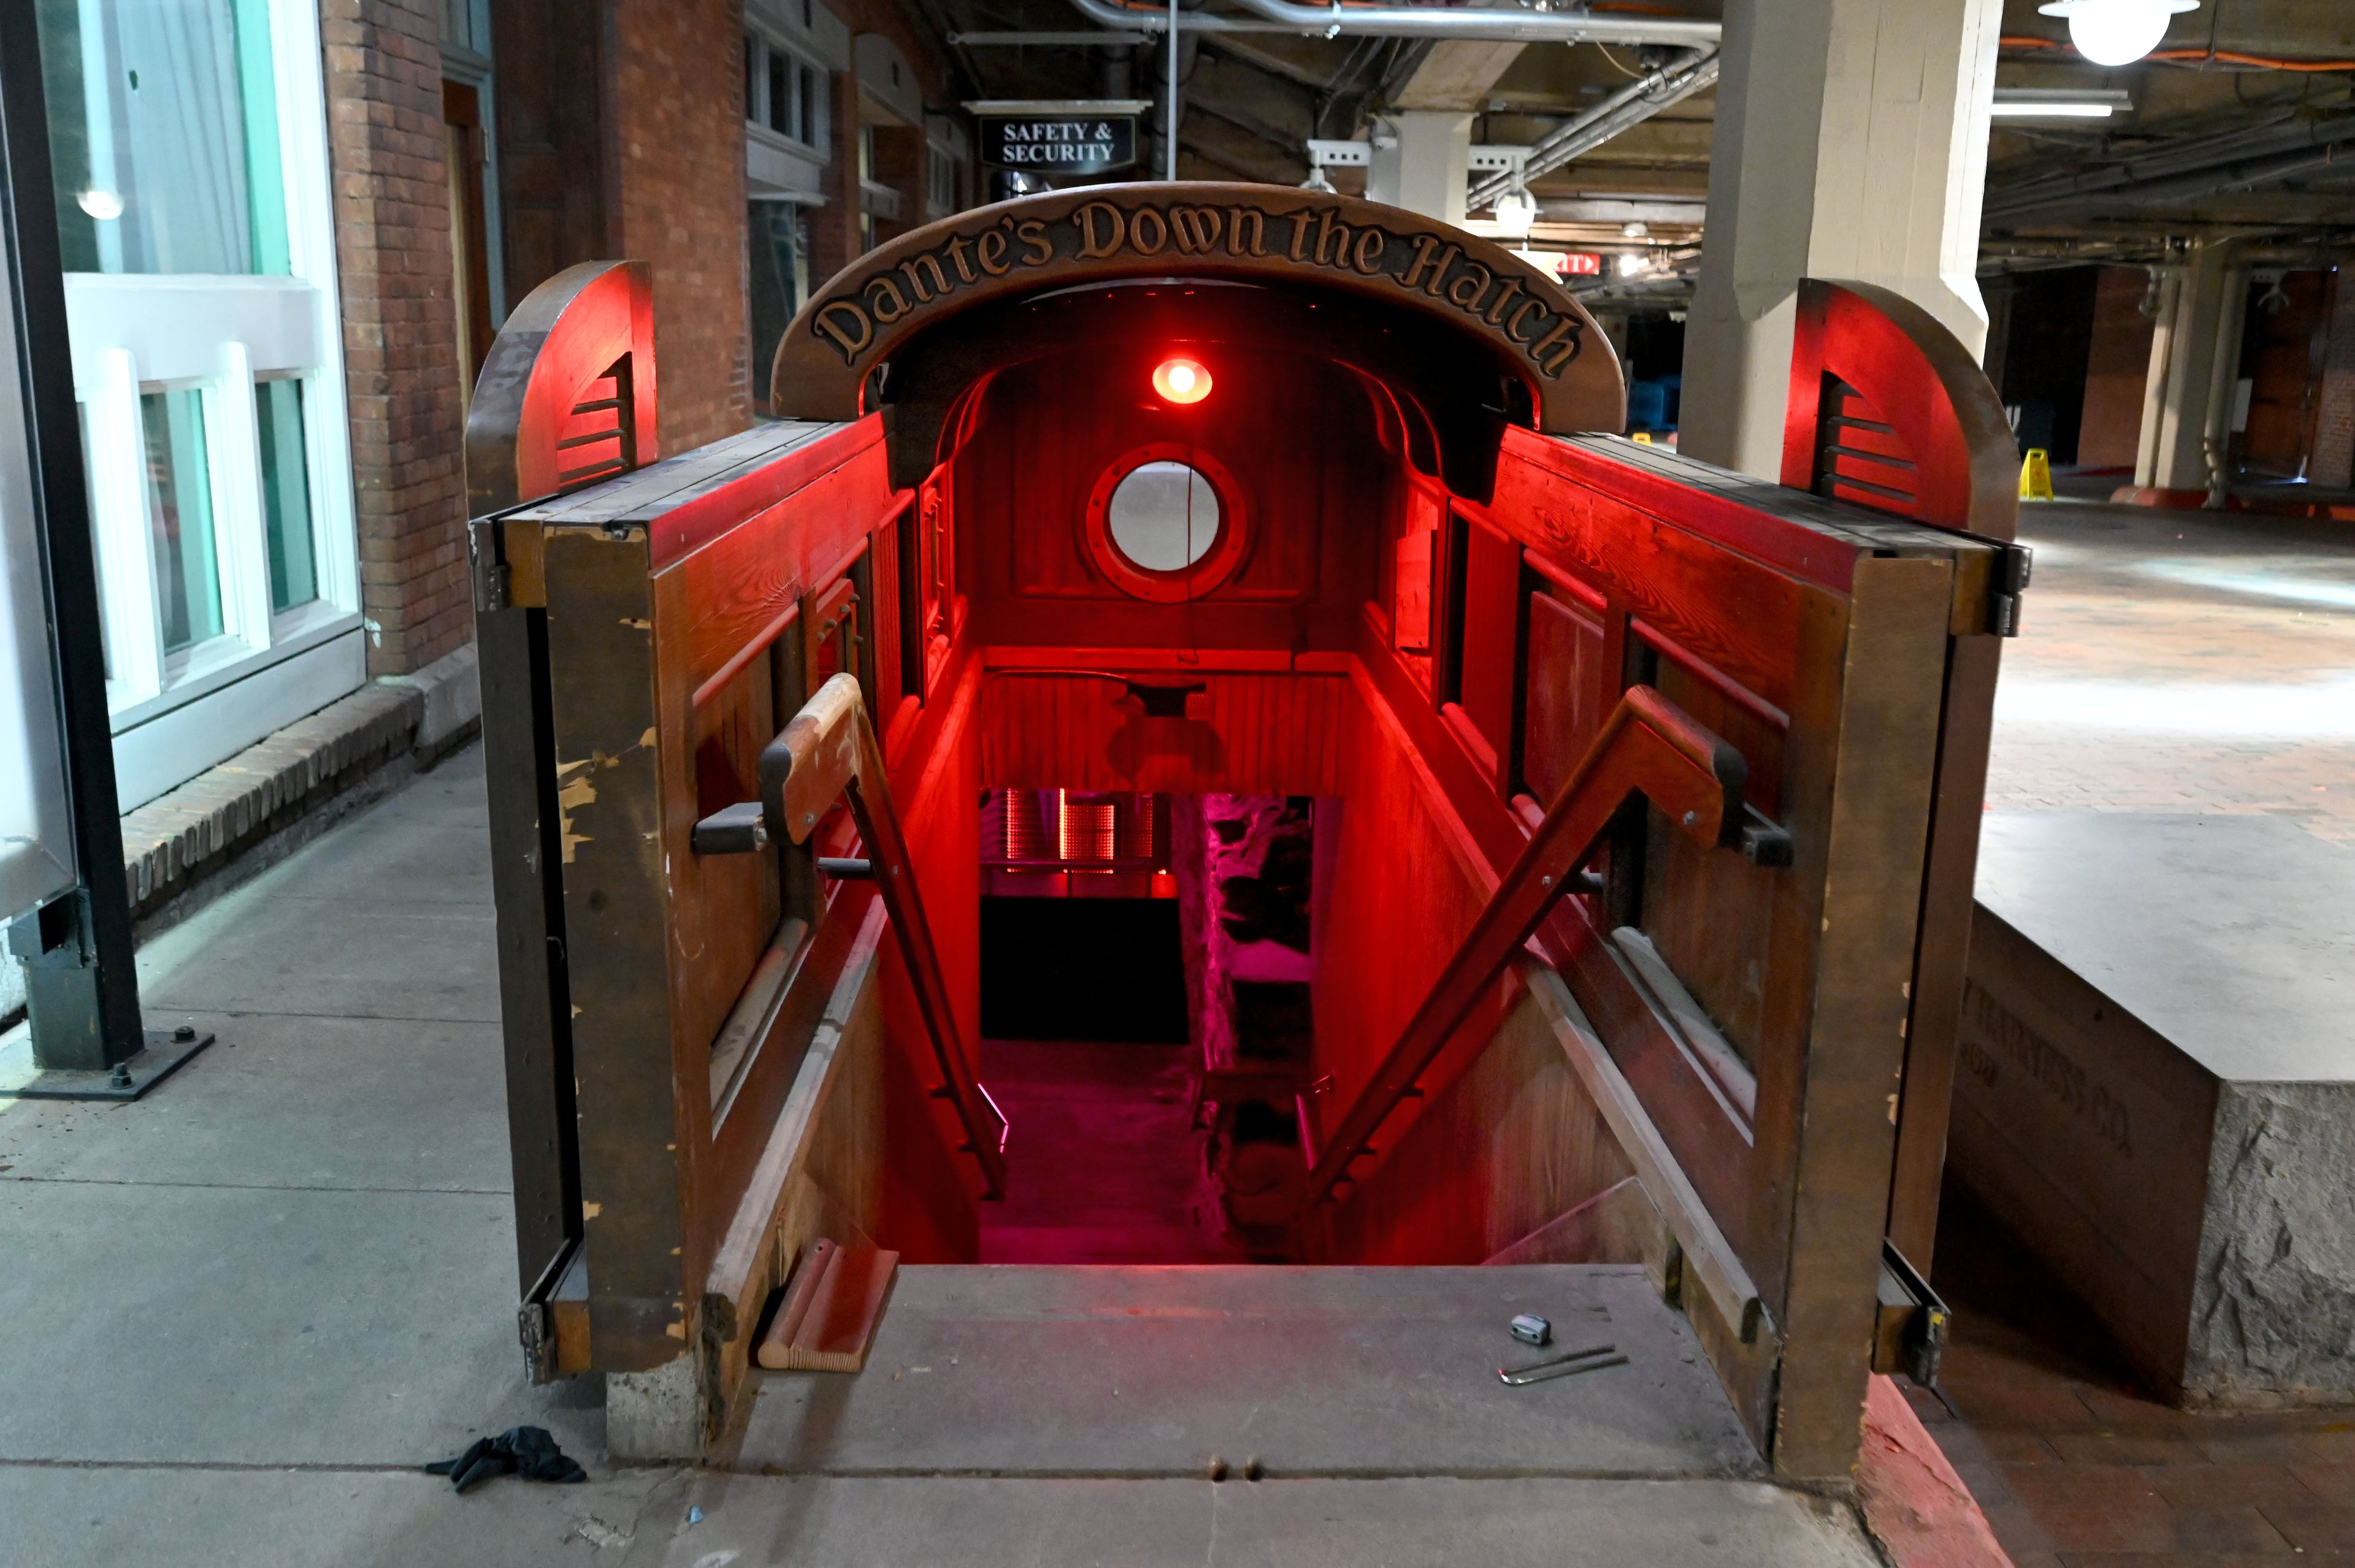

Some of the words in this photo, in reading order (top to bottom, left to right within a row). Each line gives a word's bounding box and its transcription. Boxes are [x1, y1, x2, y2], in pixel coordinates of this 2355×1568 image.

[1003, 123, 1088, 142] SAFETY
[1095, 123, 1112, 140] &
[1003, 143, 1114, 163] SECURITY
[814, 217, 1053, 365] Dante's
[1072, 201, 1268, 259] Down
[1289, 207, 1384, 274] the
[1393, 235, 1580, 375] Hatch
